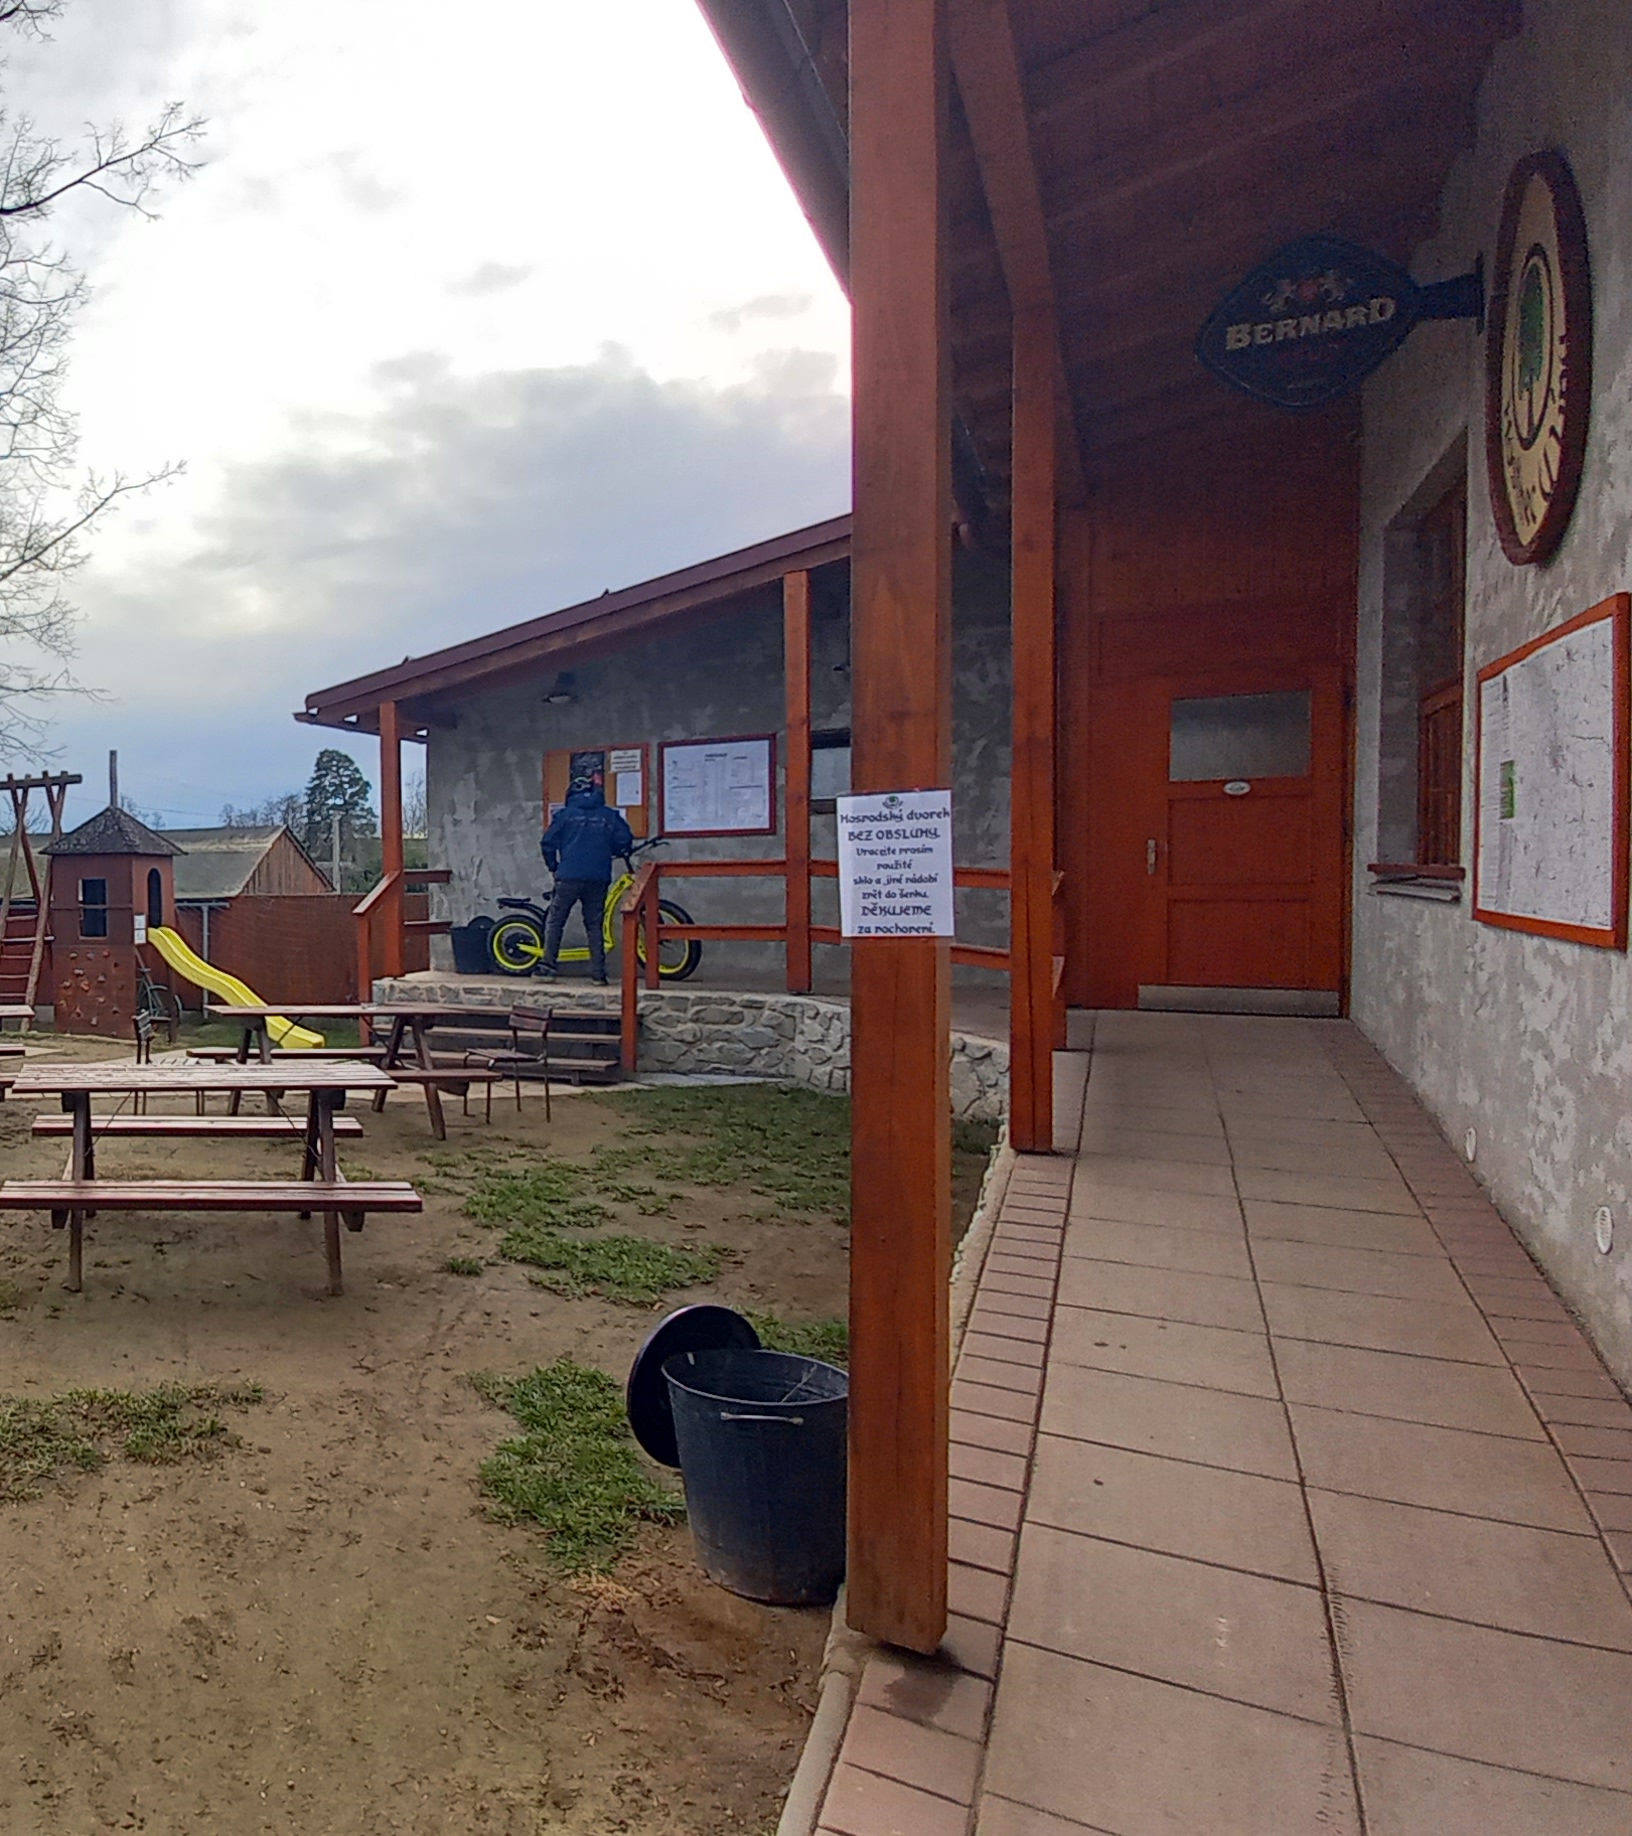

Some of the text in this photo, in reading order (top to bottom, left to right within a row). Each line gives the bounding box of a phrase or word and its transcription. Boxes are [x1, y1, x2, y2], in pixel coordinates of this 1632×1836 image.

[1225, 296, 1396, 351] BERNARD
[848, 829, 873, 842] BEZ
[875, 877, 882, 885] a
[884, 889, 897, 899] do
[861, 902, 933, 917] DĚKUJEME
[857, 925, 872, 934] za
